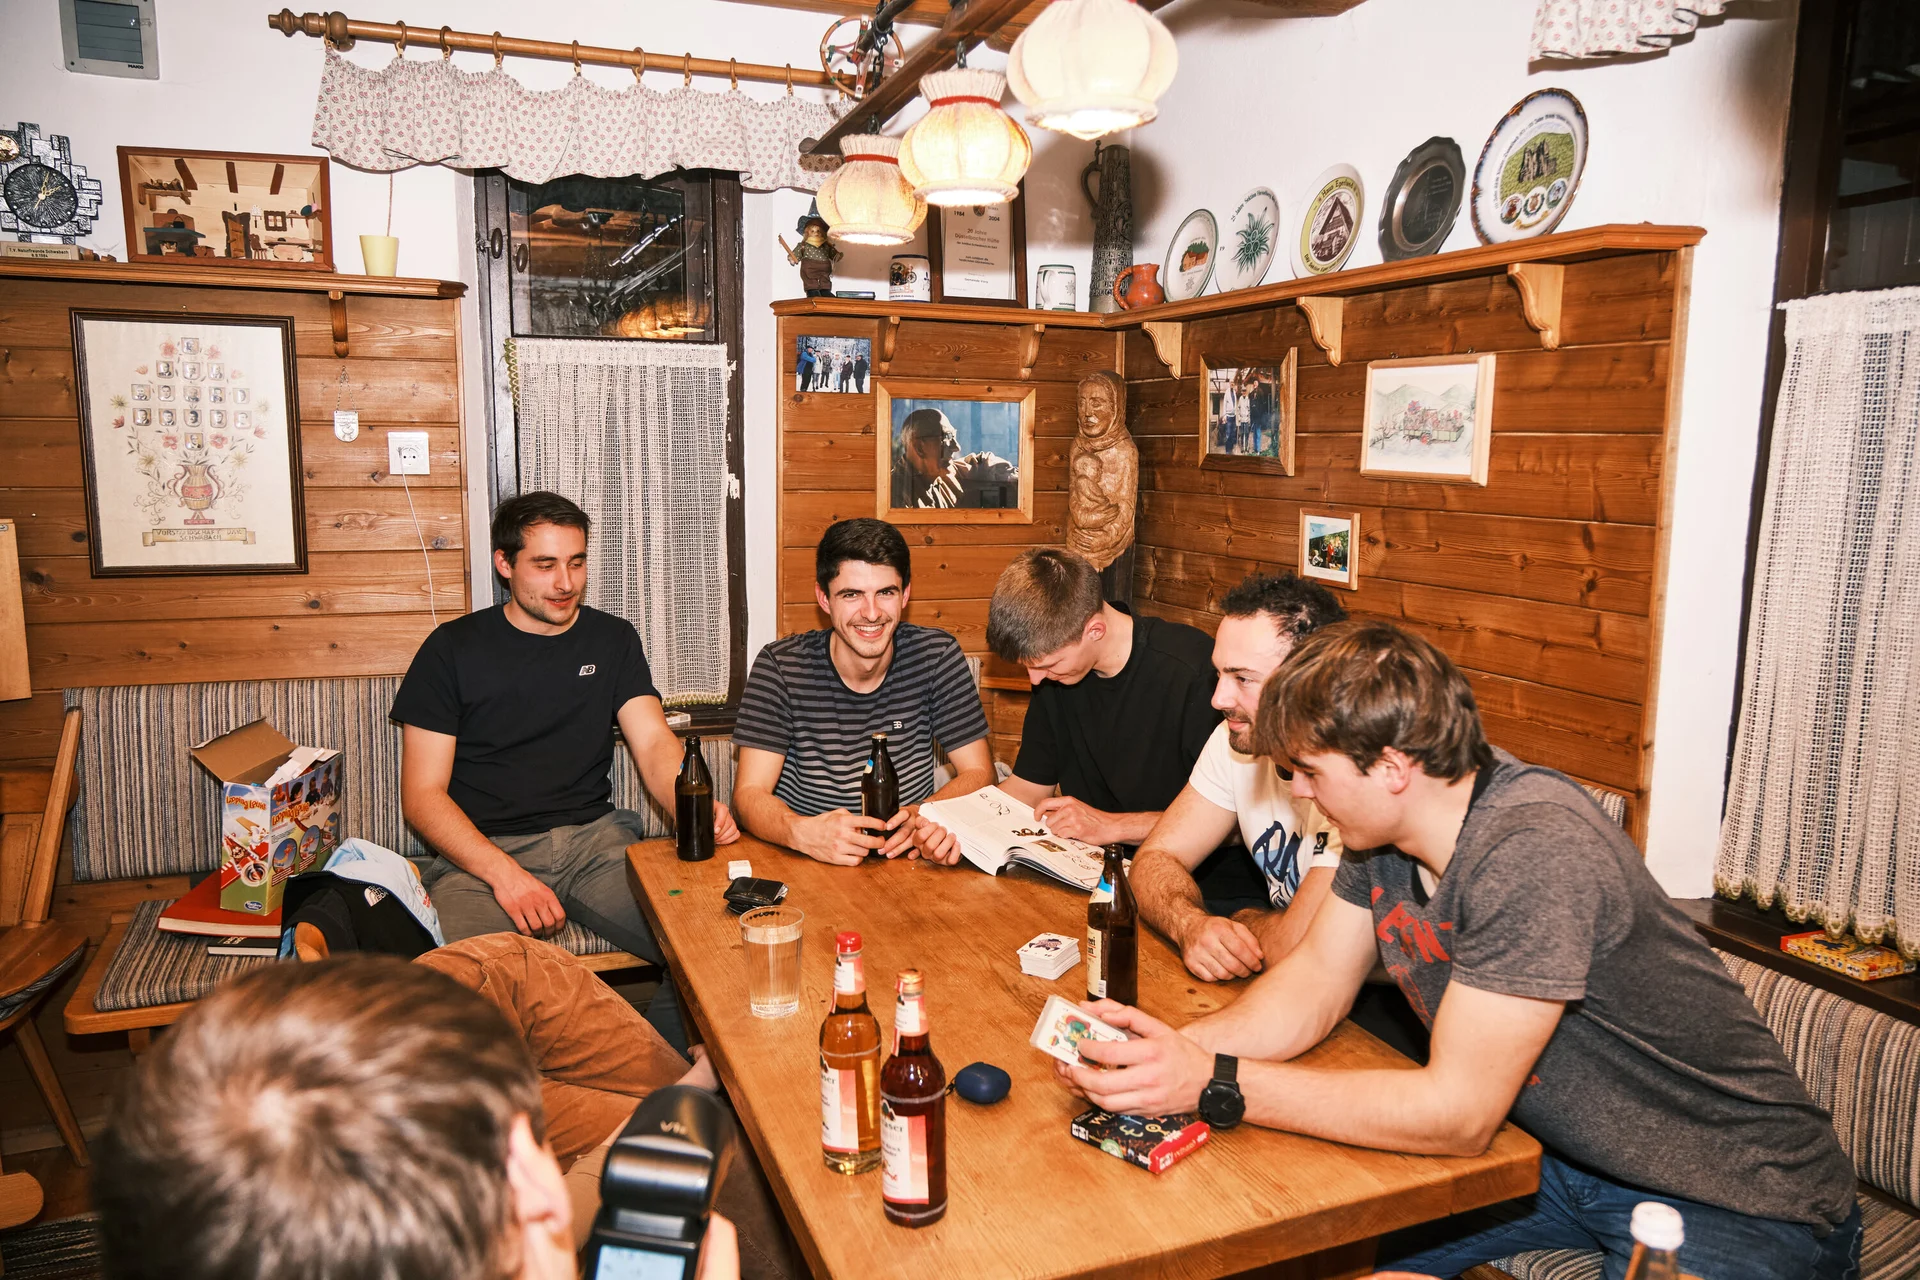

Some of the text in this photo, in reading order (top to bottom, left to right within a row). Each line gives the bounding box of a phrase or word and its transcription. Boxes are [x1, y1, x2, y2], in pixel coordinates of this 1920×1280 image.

[579, 664, 596, 676] NB
[226, 796, 248, 810] Looping
[249, 800, 266, 810] Louie
[272, 807, 293, 826] Looping
